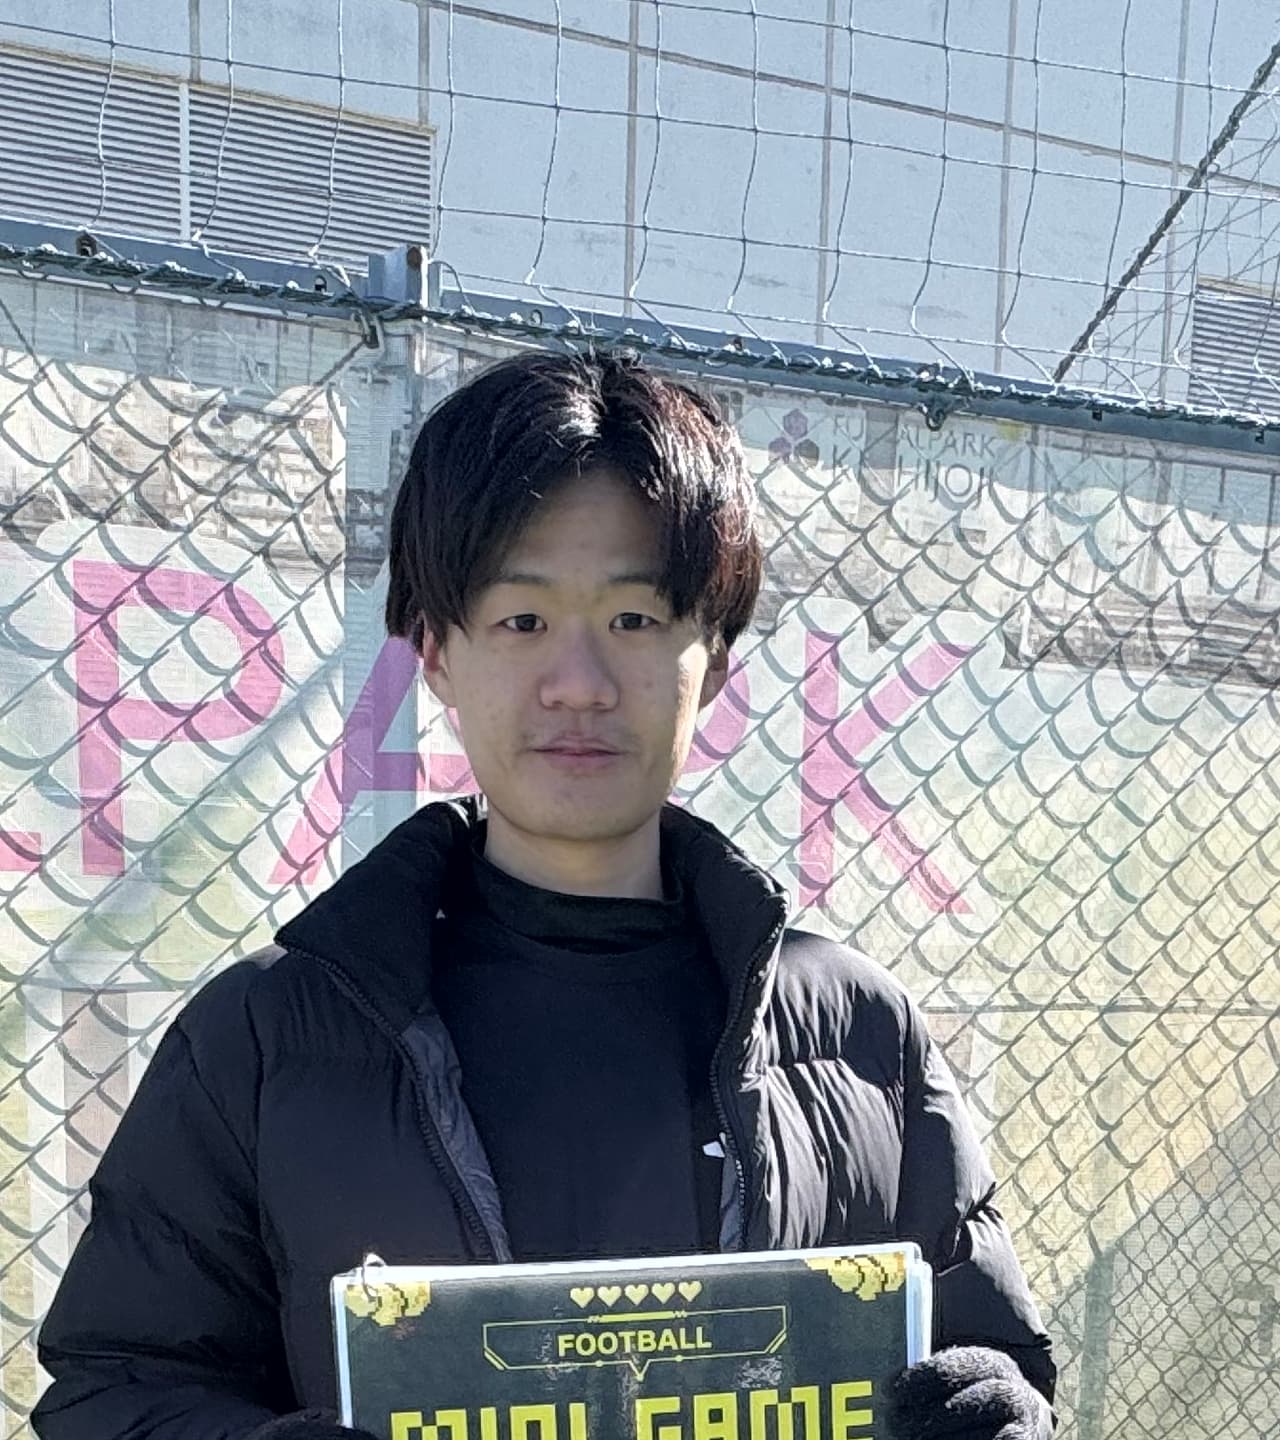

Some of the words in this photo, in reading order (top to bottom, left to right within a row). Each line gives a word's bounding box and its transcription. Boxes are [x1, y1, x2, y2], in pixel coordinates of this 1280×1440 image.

[833, 412, 996, 458] FUALPARK
[832, 444, 994, 508] KHIJOJI
[558, 1326, 712, 1357] FOOTBALL
